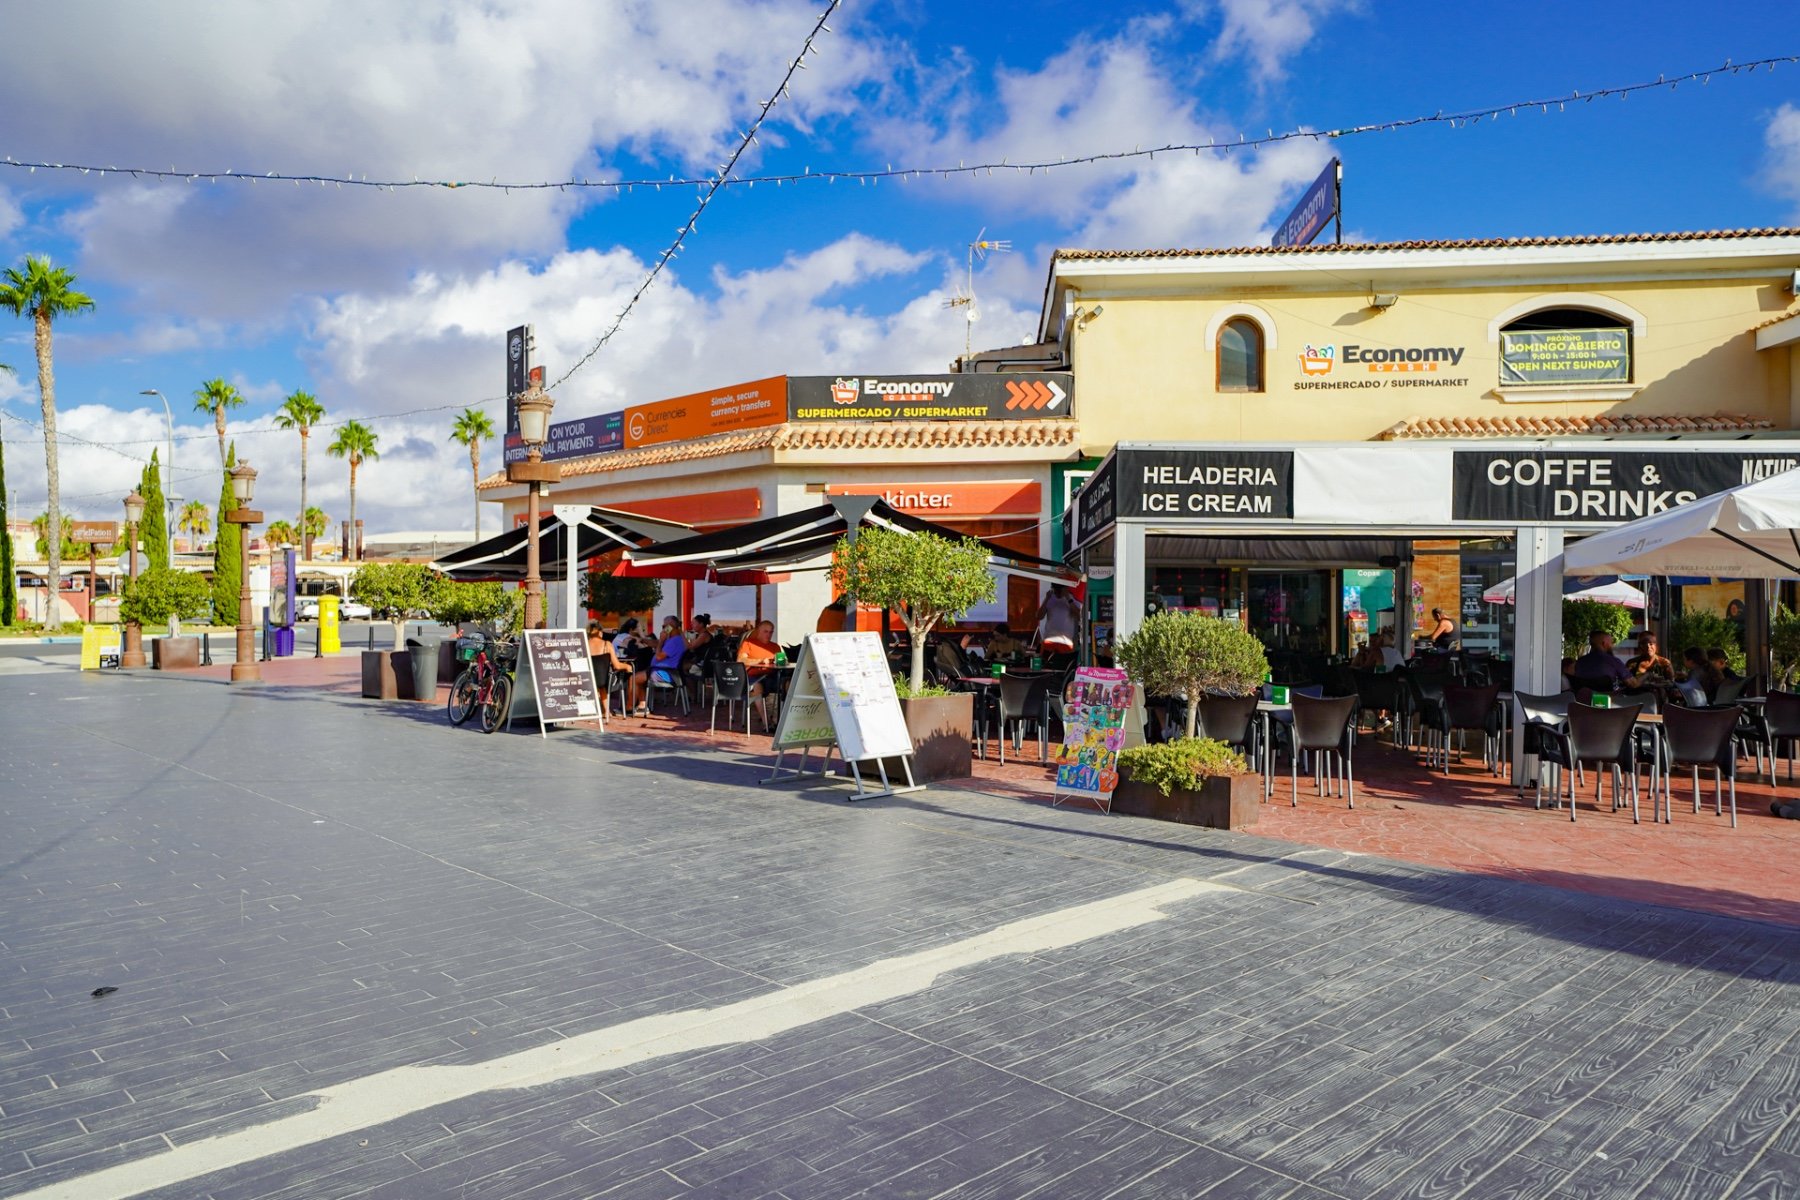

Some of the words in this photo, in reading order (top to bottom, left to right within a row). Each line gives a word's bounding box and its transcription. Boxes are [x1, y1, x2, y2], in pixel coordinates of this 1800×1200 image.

[1289, 183, 1326, 243] Economy
[1508, 342, 1566, 352] DOMINGO
[1568, 340, 1621, 351] ABIERTO
[1343, 346, 1465, 366] Economy
[1511, 362, 1540, 371] OPEN
[1543, 361, 1571, 371] NEXT
[1573, 360, 1620, 370] SUNDAY
[864, 379, 954, 397] Economy
[1294, 380, 1381, 390] SUPERMERCADO
[1391, 378, 1469, 388] SUPERMARKET
[711, 394, 735, 407] Simple,
[736, 389, 759, 401] secure
[647, 408, 687, 423] Currencies
[711, 405, 739, 418] currency
[741, 399, 771, 411] transfers
[797, 408, 892, 418] SUPERMERCADO
[903, 407, 988, 417] SUPERMARKET
[551, 428, 563, 439] ON
[564, 423, 585, 438] YOUR
[647, 423, 668, 435] Direct
[505, 443, 556, 461] INTERNNAL
[557, 436, 594, 452] PAYMENTS
[1143, 466, 1278, 486] HELADERIA
[1487, 459, 1612, 486] COFFE
[1641, 464, 1662, 486] &
[1142, 493, 1180, 512] ICE
[1187, 493, 1272, 513] CREAM
[1357, 569, 1380, 578] Copas
